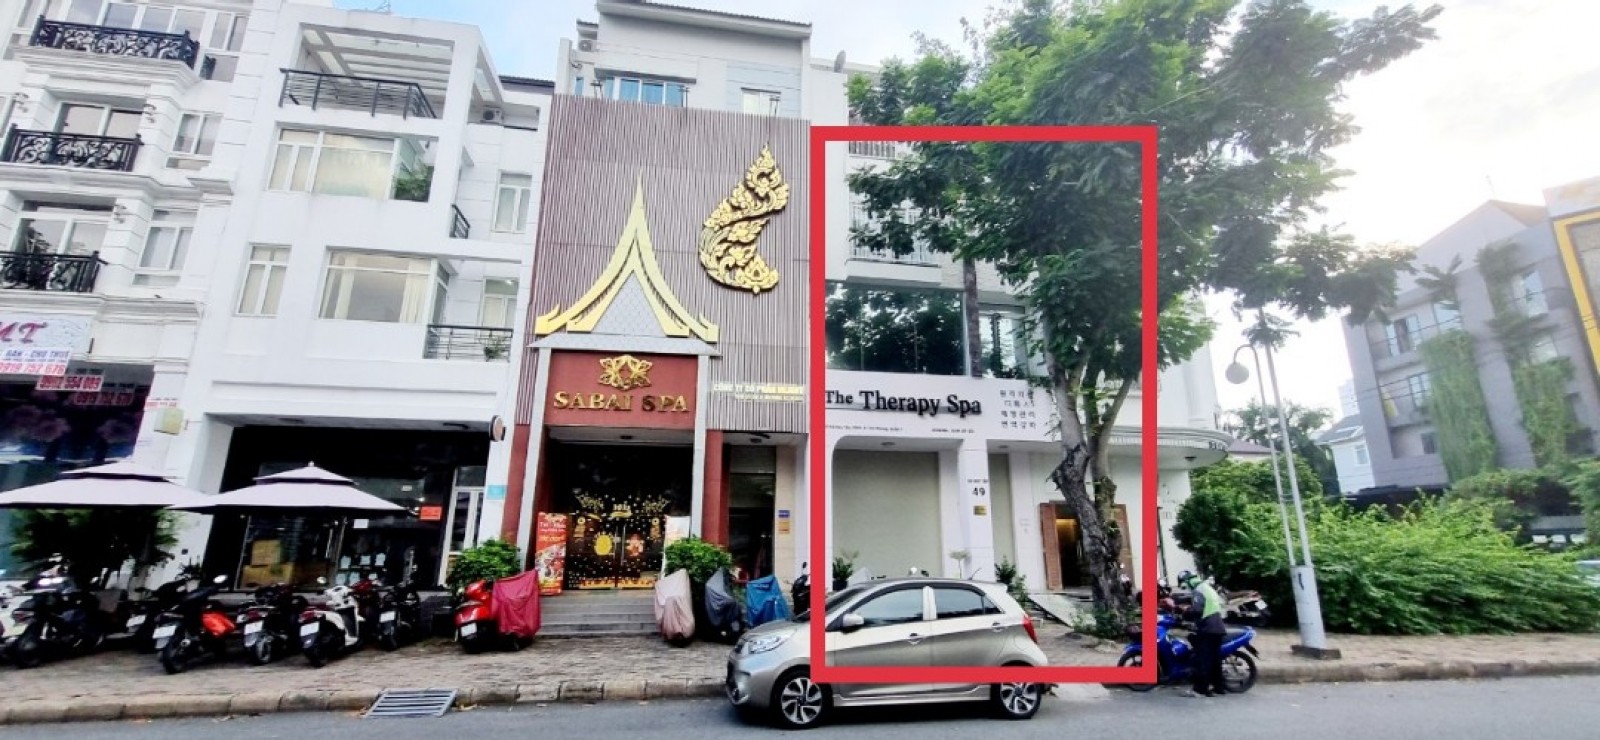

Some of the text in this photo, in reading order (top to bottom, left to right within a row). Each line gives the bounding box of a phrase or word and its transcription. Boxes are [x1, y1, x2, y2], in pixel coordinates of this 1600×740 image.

[553, 391, 690, 412] SABAI SPA
[825, 390, 853, 404] The
[859, 390, 941, 417] Therapy
[946, 394, 982, 418] Spa
[972, 487, 986, 496] 49
